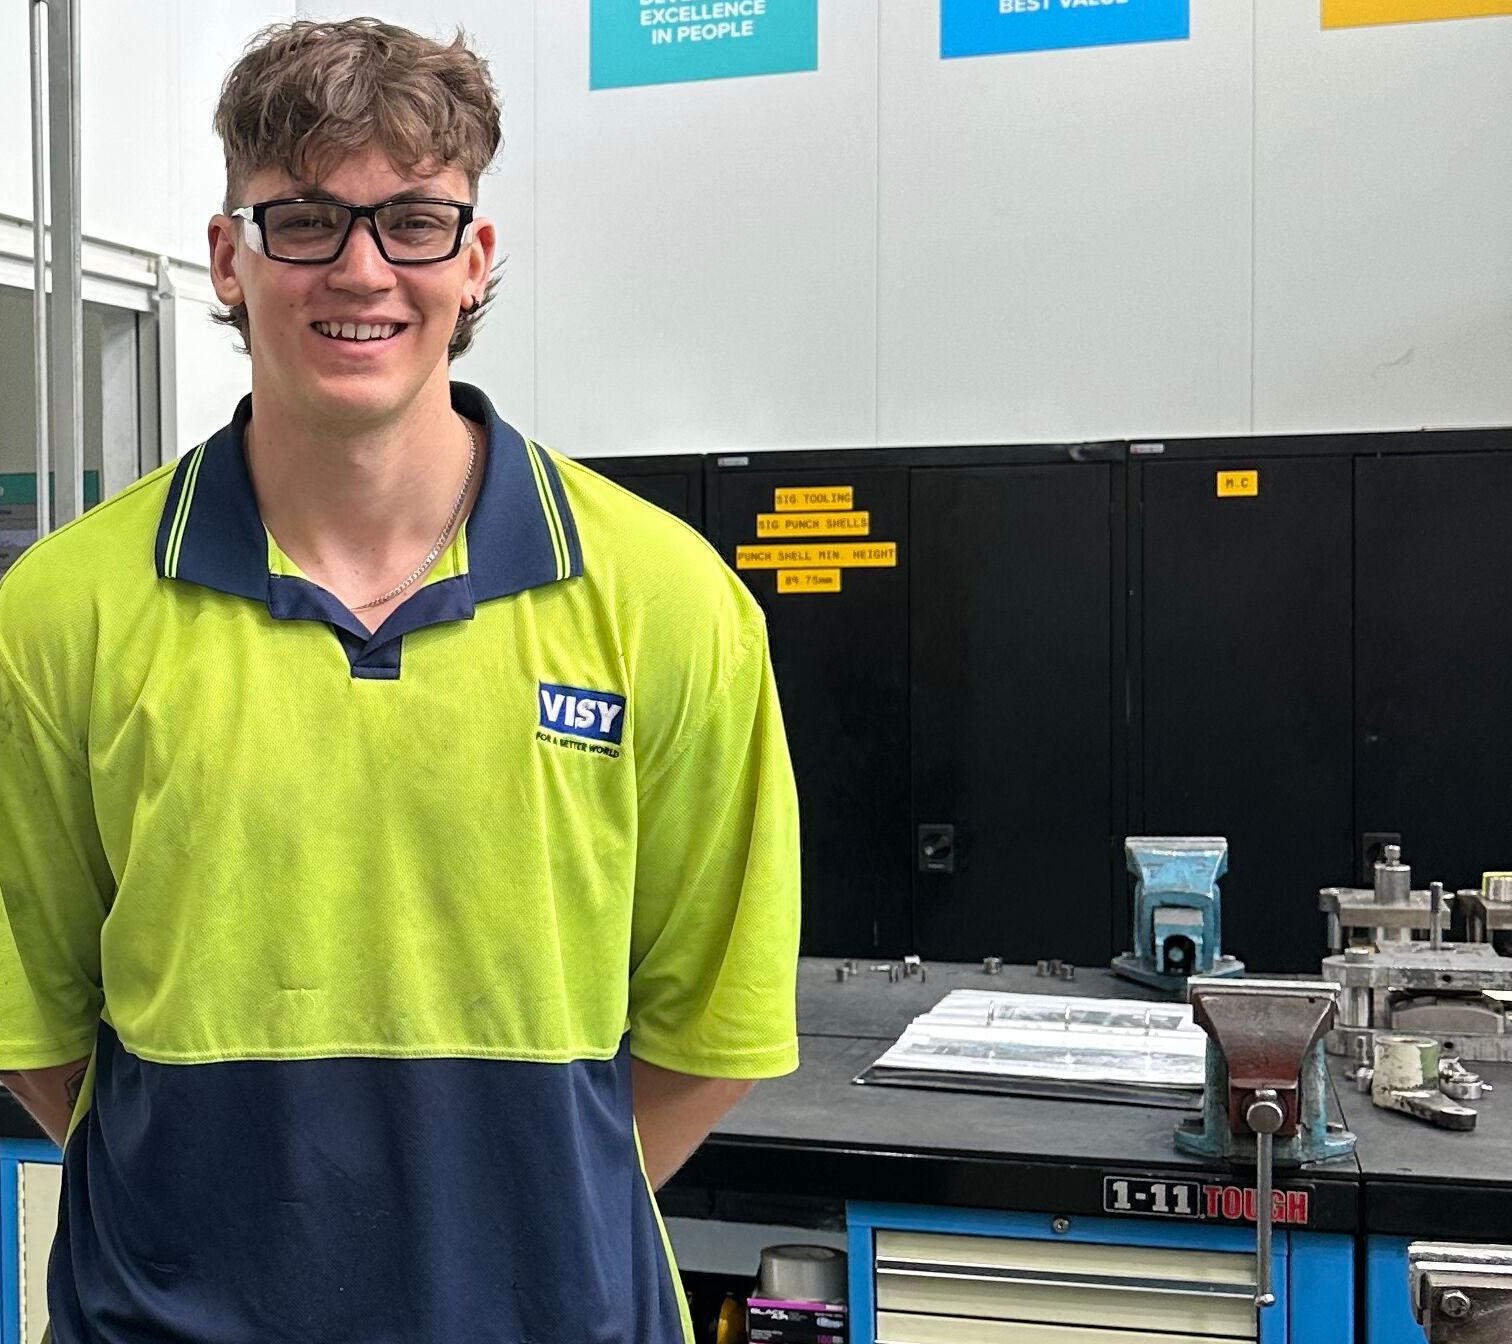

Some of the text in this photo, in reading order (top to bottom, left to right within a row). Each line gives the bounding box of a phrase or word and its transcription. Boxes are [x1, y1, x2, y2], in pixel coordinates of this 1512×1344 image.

[651, 20, 754, 45] IN PEOPLE
[776, 492, 851, 505] SIG TOOLING
[758, 517, 868, 531] SIG PUNCH SHELLS
[737, 551, 772, 562] PUNCH
[778, 551, 812, 562] SHELL
[852, 548, 894, 560] HEIGHT
[541, 689, 622, 733] VISY
[536, 731, 620, 759] FOR A BETTER WORLD
[1112, 1181, 1309, 1224] 1-11 TOUGH
